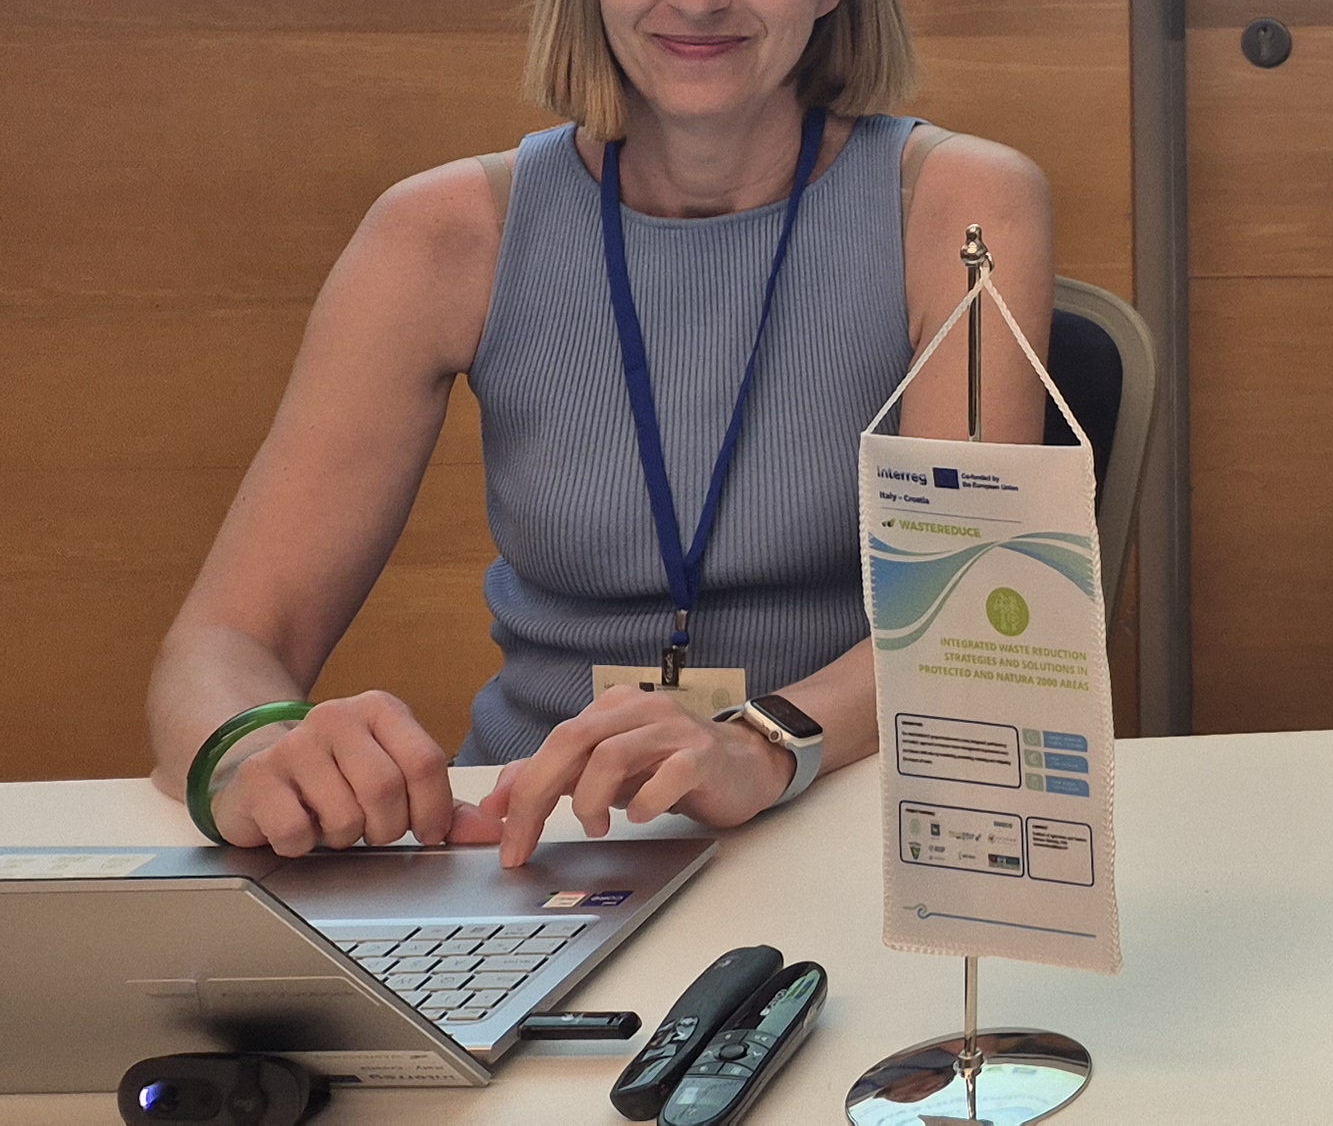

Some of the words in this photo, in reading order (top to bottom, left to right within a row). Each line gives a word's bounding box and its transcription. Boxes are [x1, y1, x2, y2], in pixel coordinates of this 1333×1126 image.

[877, 466, 928, 486] Interreg
[879, 491, 897, 502] Italy
[899, 520, 982, 538] WASTEREDUCE
[940, 637, 997, 652] INTEGRATED
[1000, 643, 1030, 655] WASTE
[1032, 646, 1087, 661] REDUCTION
[944, 652, 997, 666] STRATEGIES
[1000, 658, 1020, 669] AND
[1022, 660, 1075, 675] SOLUTIONS
[919, 664, 971, 678] PROTECTED
[973, 668, 994, 680] AND
[996, 672, 1034, 686] NATURA
[1060, 678, 1089, 691] AREAS
